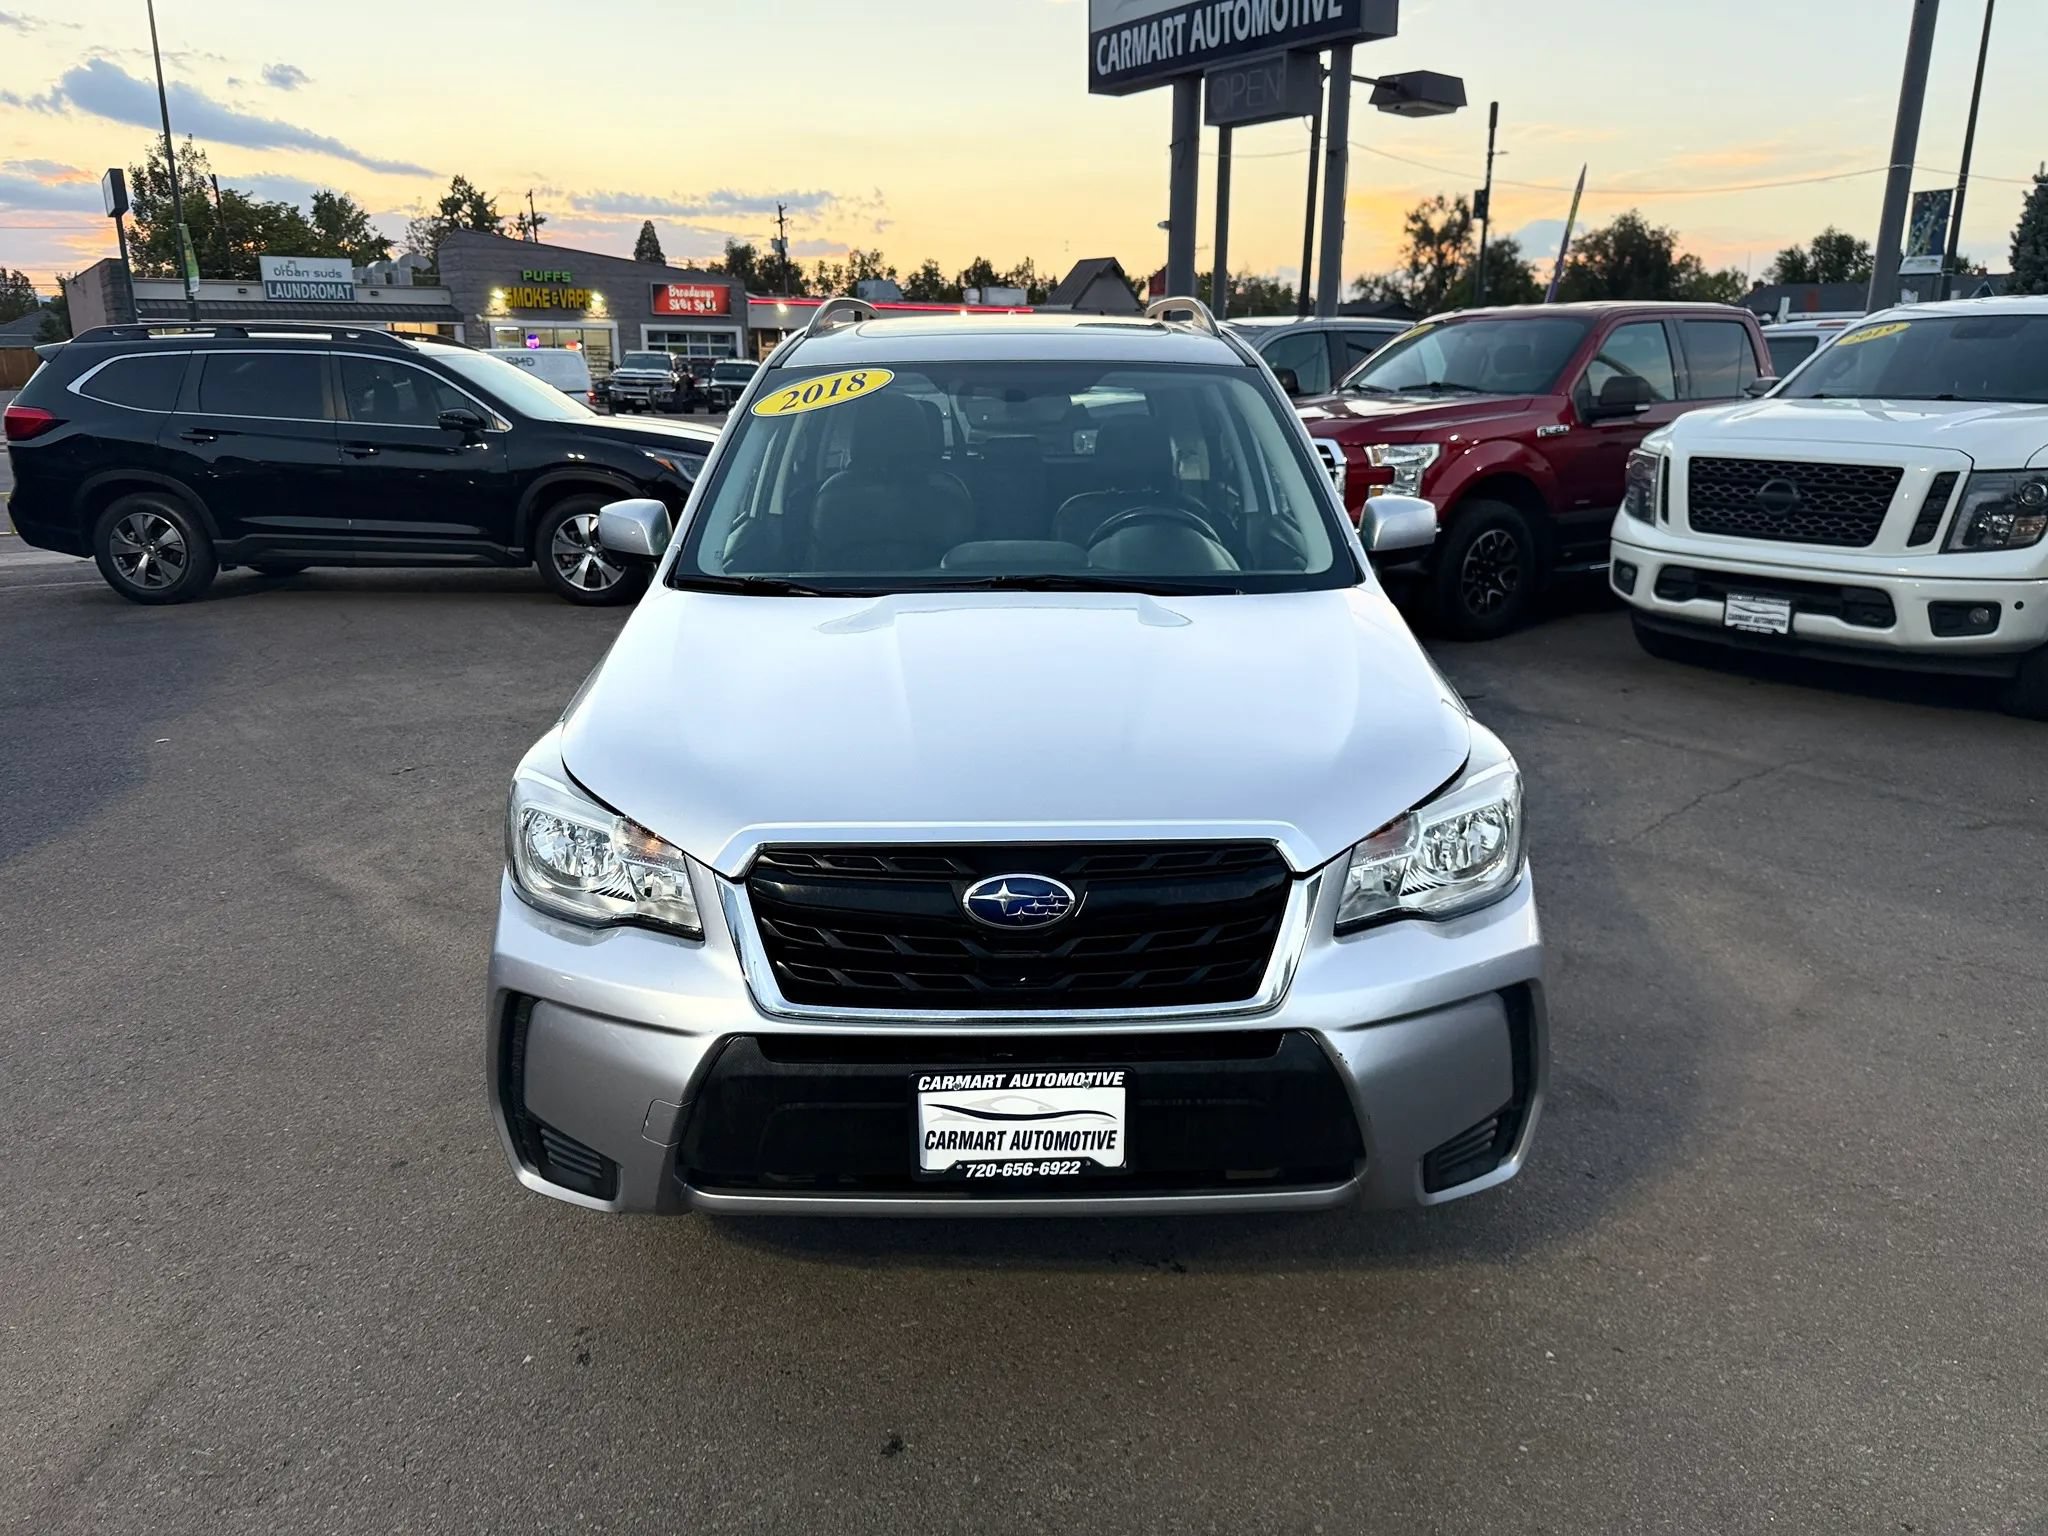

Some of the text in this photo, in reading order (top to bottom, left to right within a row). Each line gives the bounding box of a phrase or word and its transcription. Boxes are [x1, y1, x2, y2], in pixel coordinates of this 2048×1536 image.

[1096, 13, 1186, 76] CARMART
[1211, 65, 1281, 113] OPEN
[313, 268, 343, 279] suds
[522, 269, 573, 282] PUFFS
[267, 282, 352, 300] LAUNDROMAT
[503, 286, 551, 309] SMOKE
[551, 291, 559, 305] &
[778, 372, 868, 412] 2018
[918, 1072, 1125, 1091] CARMART AUTOMOTIVE
[925, 1129, 1118, 1151] CARMART AUTOMOTIVE
[966, 1160, 1081, 1179] 720-656-6922
